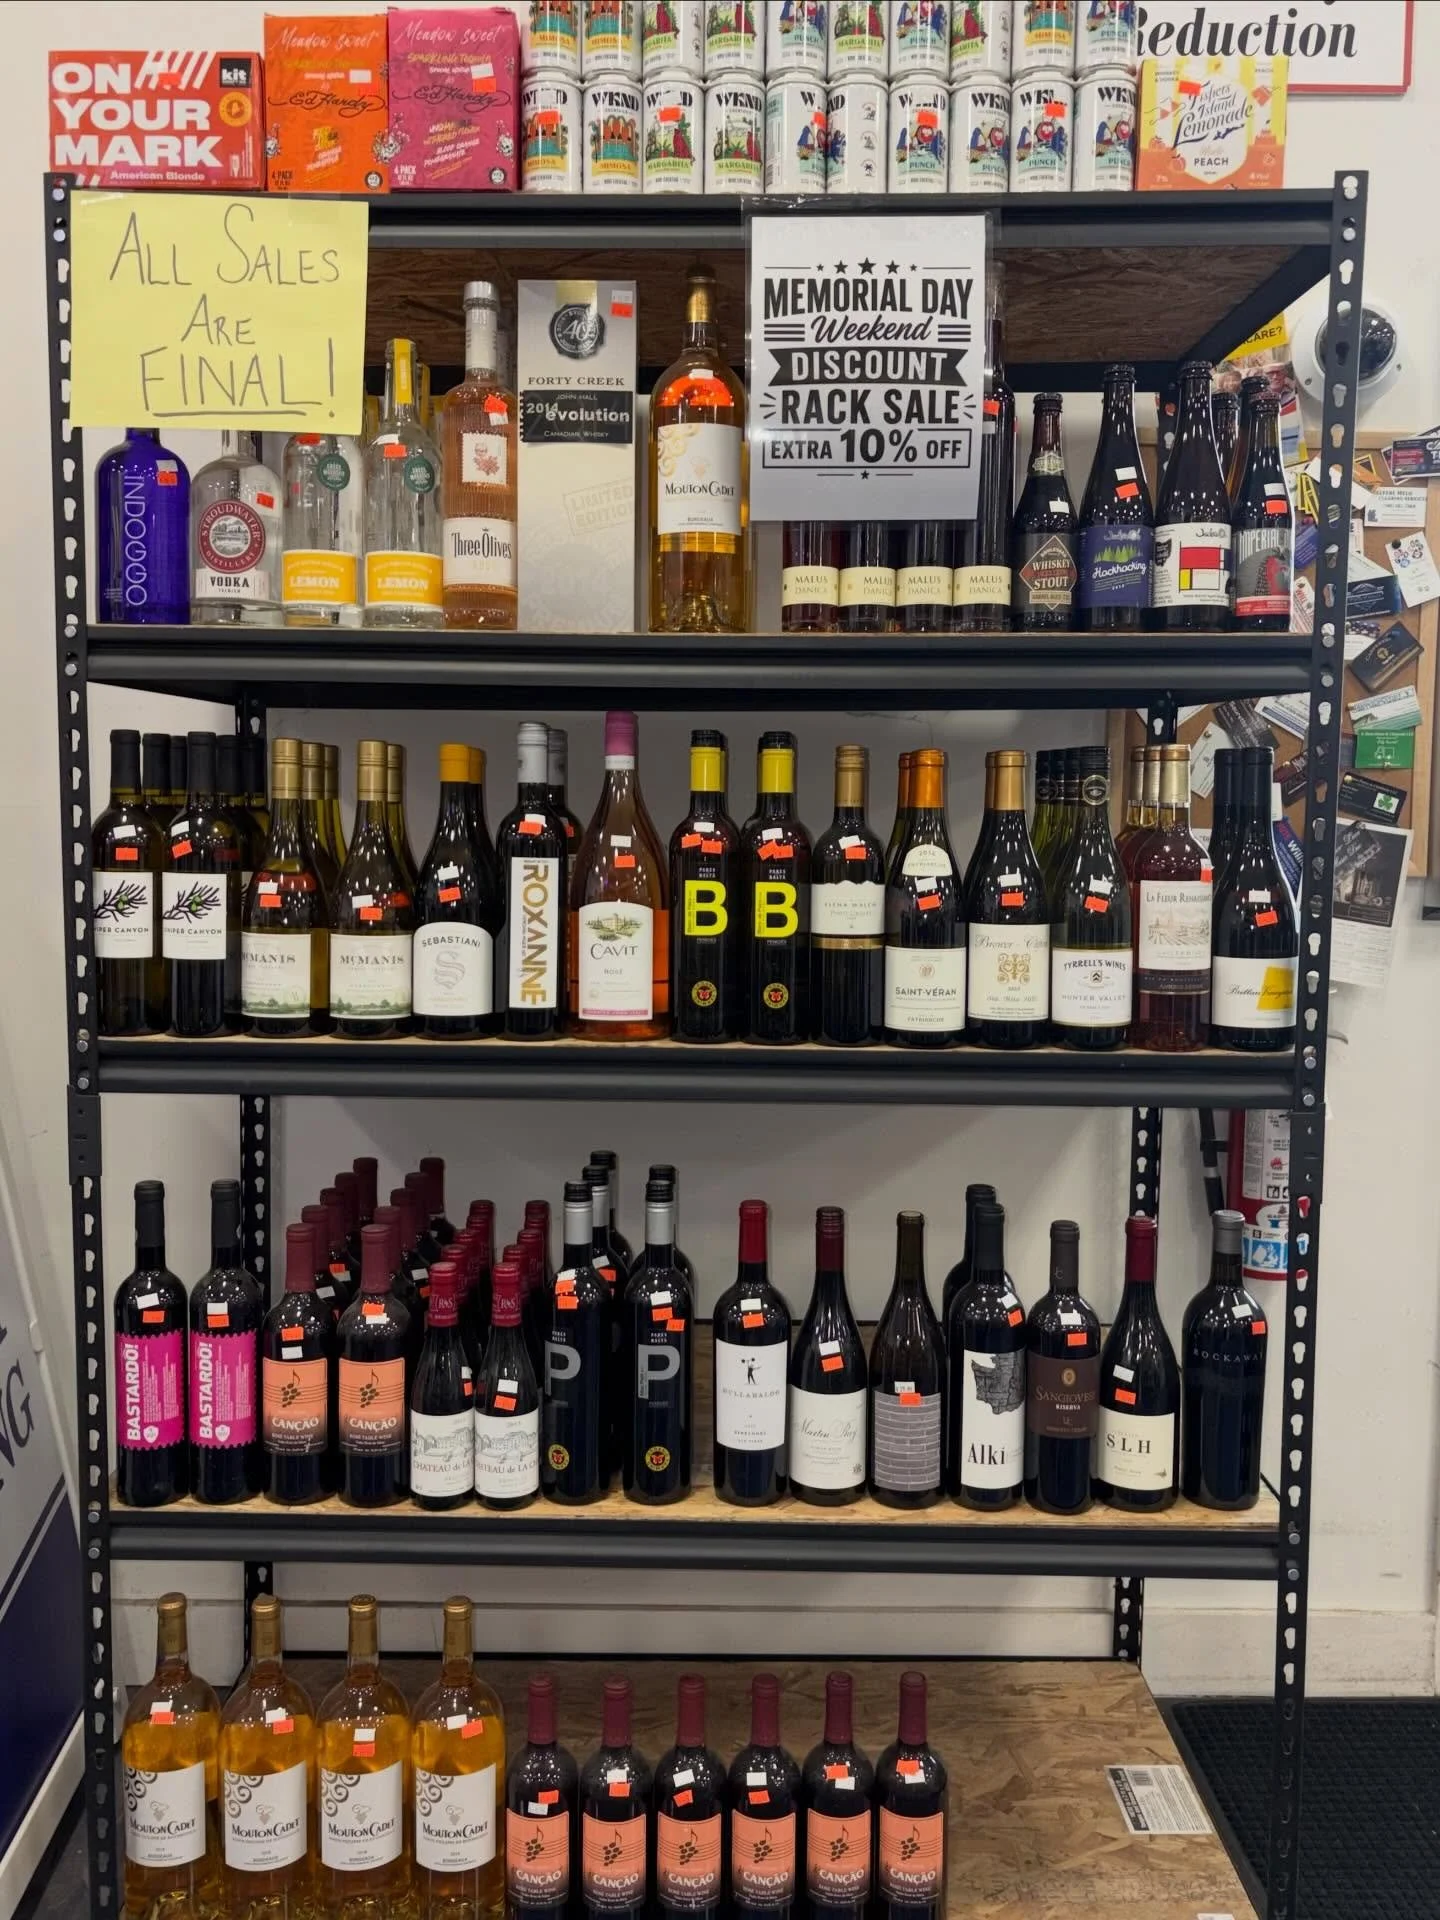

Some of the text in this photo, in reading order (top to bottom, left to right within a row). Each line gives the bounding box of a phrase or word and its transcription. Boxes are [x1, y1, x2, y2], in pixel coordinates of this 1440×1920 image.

[272, 26, 330, 50] Meadow
[393, 19, 456, 44] Meadow
[51, 62, 131, 94] ON
[222, 68, 247, 79] kit
[592, 91, 640, 113] WKND
[716, 92, 763, 114] WKND
[1197, 92, 1237, 118] Island
[53, 99, 211, 131] YOUR
[1172, 101, 1254, 149] Lemonade
[55, 135, 223, 167] MARK
[400, 165, 416, 175] PACK
[909, 161, 936, 169] PUNCH
[1028, 158, 1056, 167] PUNCH
[1194, 157, 1229, 166] PEACH
[110, 170, 205, 181] American Blonde
[278, 171, 293, 180] PACK
[764, 278, 974, 320] MEMORIAL DAY
[811, 314, 934, 344] Weekend
[791, 350, 948, 382] DISCOUNT
[527, 376, 625, 386] FORTY CREEK
[556, 393, 598, 401] JOHN HALL
[526, 402, 559, 415] 2014
[545, 407, 630, 422] evolution
[781, 389, 960, 425] RACK SALE
[770, 428, 963, 463] EXTRA 10% OFF
[665, 481, 736, 497] MOUTON CADET
[201, 503, 262, 538] STROUDWATER
[123, 475, 148, 606] INDOGGO
[451, 531, 512, 560] Three Olives
[206, 550, 255, 568] DISTILLERY
[1032, 558, 1071, 571] WHISKEY
[210, 576, 250, 588] VODKA
[289, 575, 340, 588] LEMON
[377, 577, 429, 590] LEMON
[795, 575, 829, 584] MALUS
[907, 575, 941, 585] MALUS
[969, 575, 1003, 584] MALUS
[1034, 576, 1069, 590] STOUT
[685, 880, 728, 936] B
[755, 881, 799, 938] B
[114, 926, 149, 934] CANYON
[519, 864, 549, 1005] ROXANNE
[422, 935, 481, 948] SEBASTIANI
[590, 943, 639, 960] CAVIT
[1063, 959, 1126, 972] TYRRELL'S WINES
[895, 986, 957, 997] SAINT-VÉRAN
[544, 1340, 582, 1397] P
[637, 1343, 681, 1399] P
[124, 1343, 141, 1441] BASTARDO!
[199, 1341, 213, 1439] BASTARDO!
[722, 1388, 781, 1399] HULLABALOO
[1055, 1403, 1081, 1411] RISERVA
[799, 1418, 830, 1438] Martin
[967, 1442, 1006, 1465] Alki
[507, 1464, 516, 1473] de
[129, 1816, 196, 1835] MOUTON CADET
[232, 1817, 300, 1838] MOUTON CADET
[328, 1818, 396, 1836] MOUTON CADET
[422, 1820, 489, 1839] MOUTON CADET
